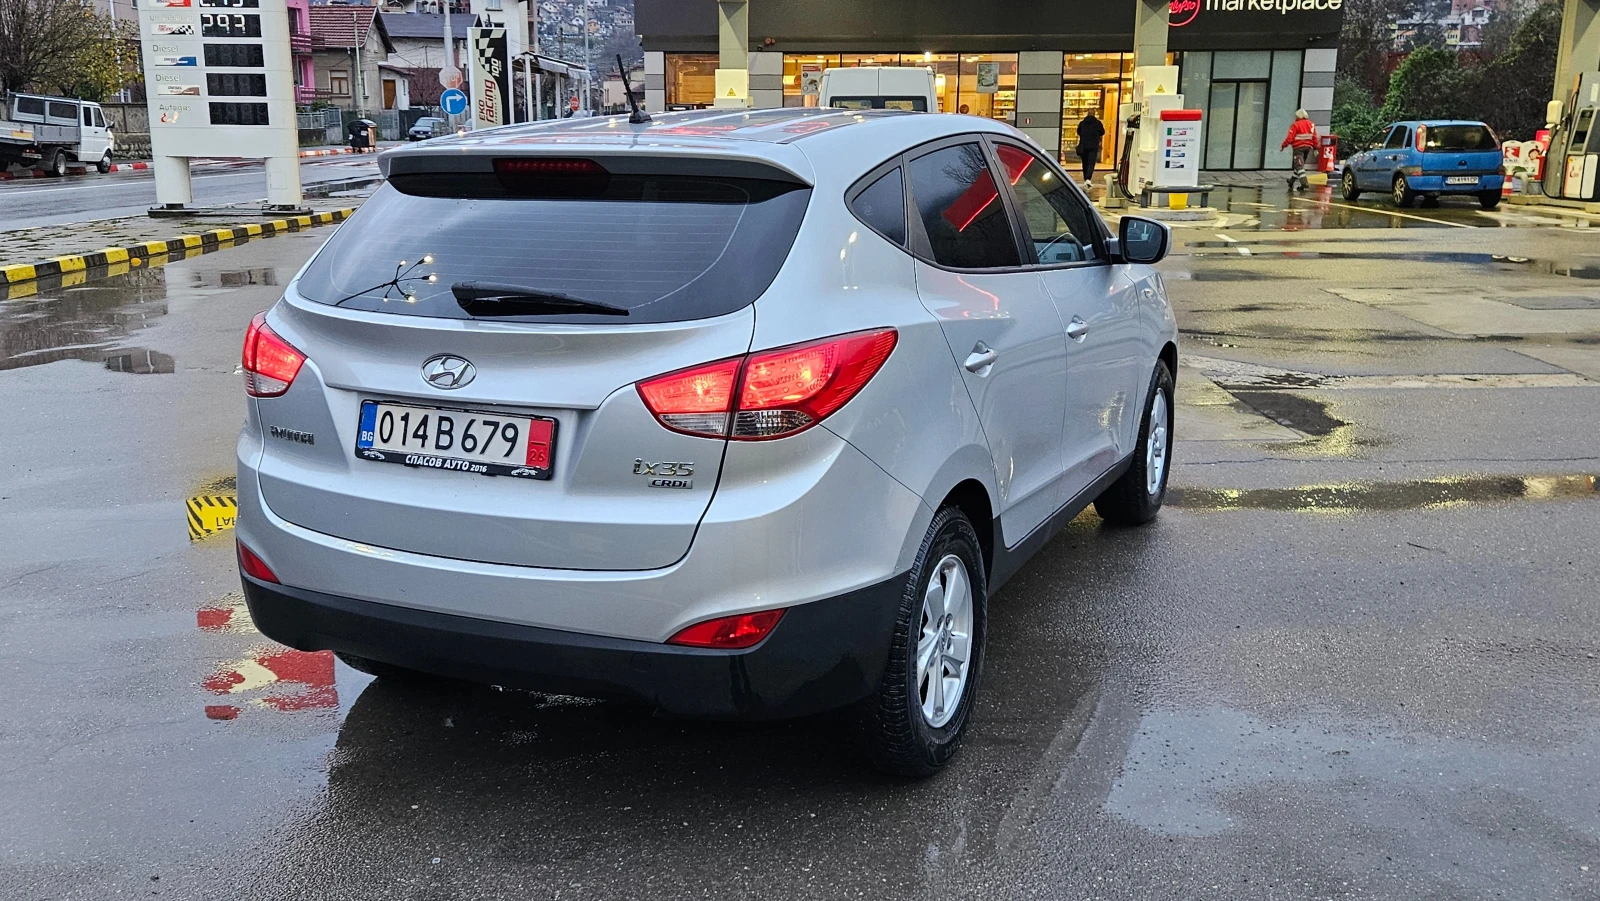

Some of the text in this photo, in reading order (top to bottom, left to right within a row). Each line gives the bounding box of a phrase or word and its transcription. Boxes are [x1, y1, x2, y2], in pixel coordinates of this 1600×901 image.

[1169, 0, 1196, 13] alypso
[1206, 0, 1342, 14] marketplace
[152, 44, 179, 52] Diesel
[490, 58, 500, 78] 100
[155, 74, 181, 82] Diesel
[159, 104, 192, 113] Autogas
[484, 79, 496, 124] racing
[478, 99, 486, 121] EKO
[361, 430, 374, 442] BG
[379, 410, 519, 458] 014B679
[529, 449, 544, 463] 26
[405, 454, 488, 473] СПАСОВ АУТО 2016
[633, 457, 695, 477] ix35
[651, 479, 688, 488] CRDi
